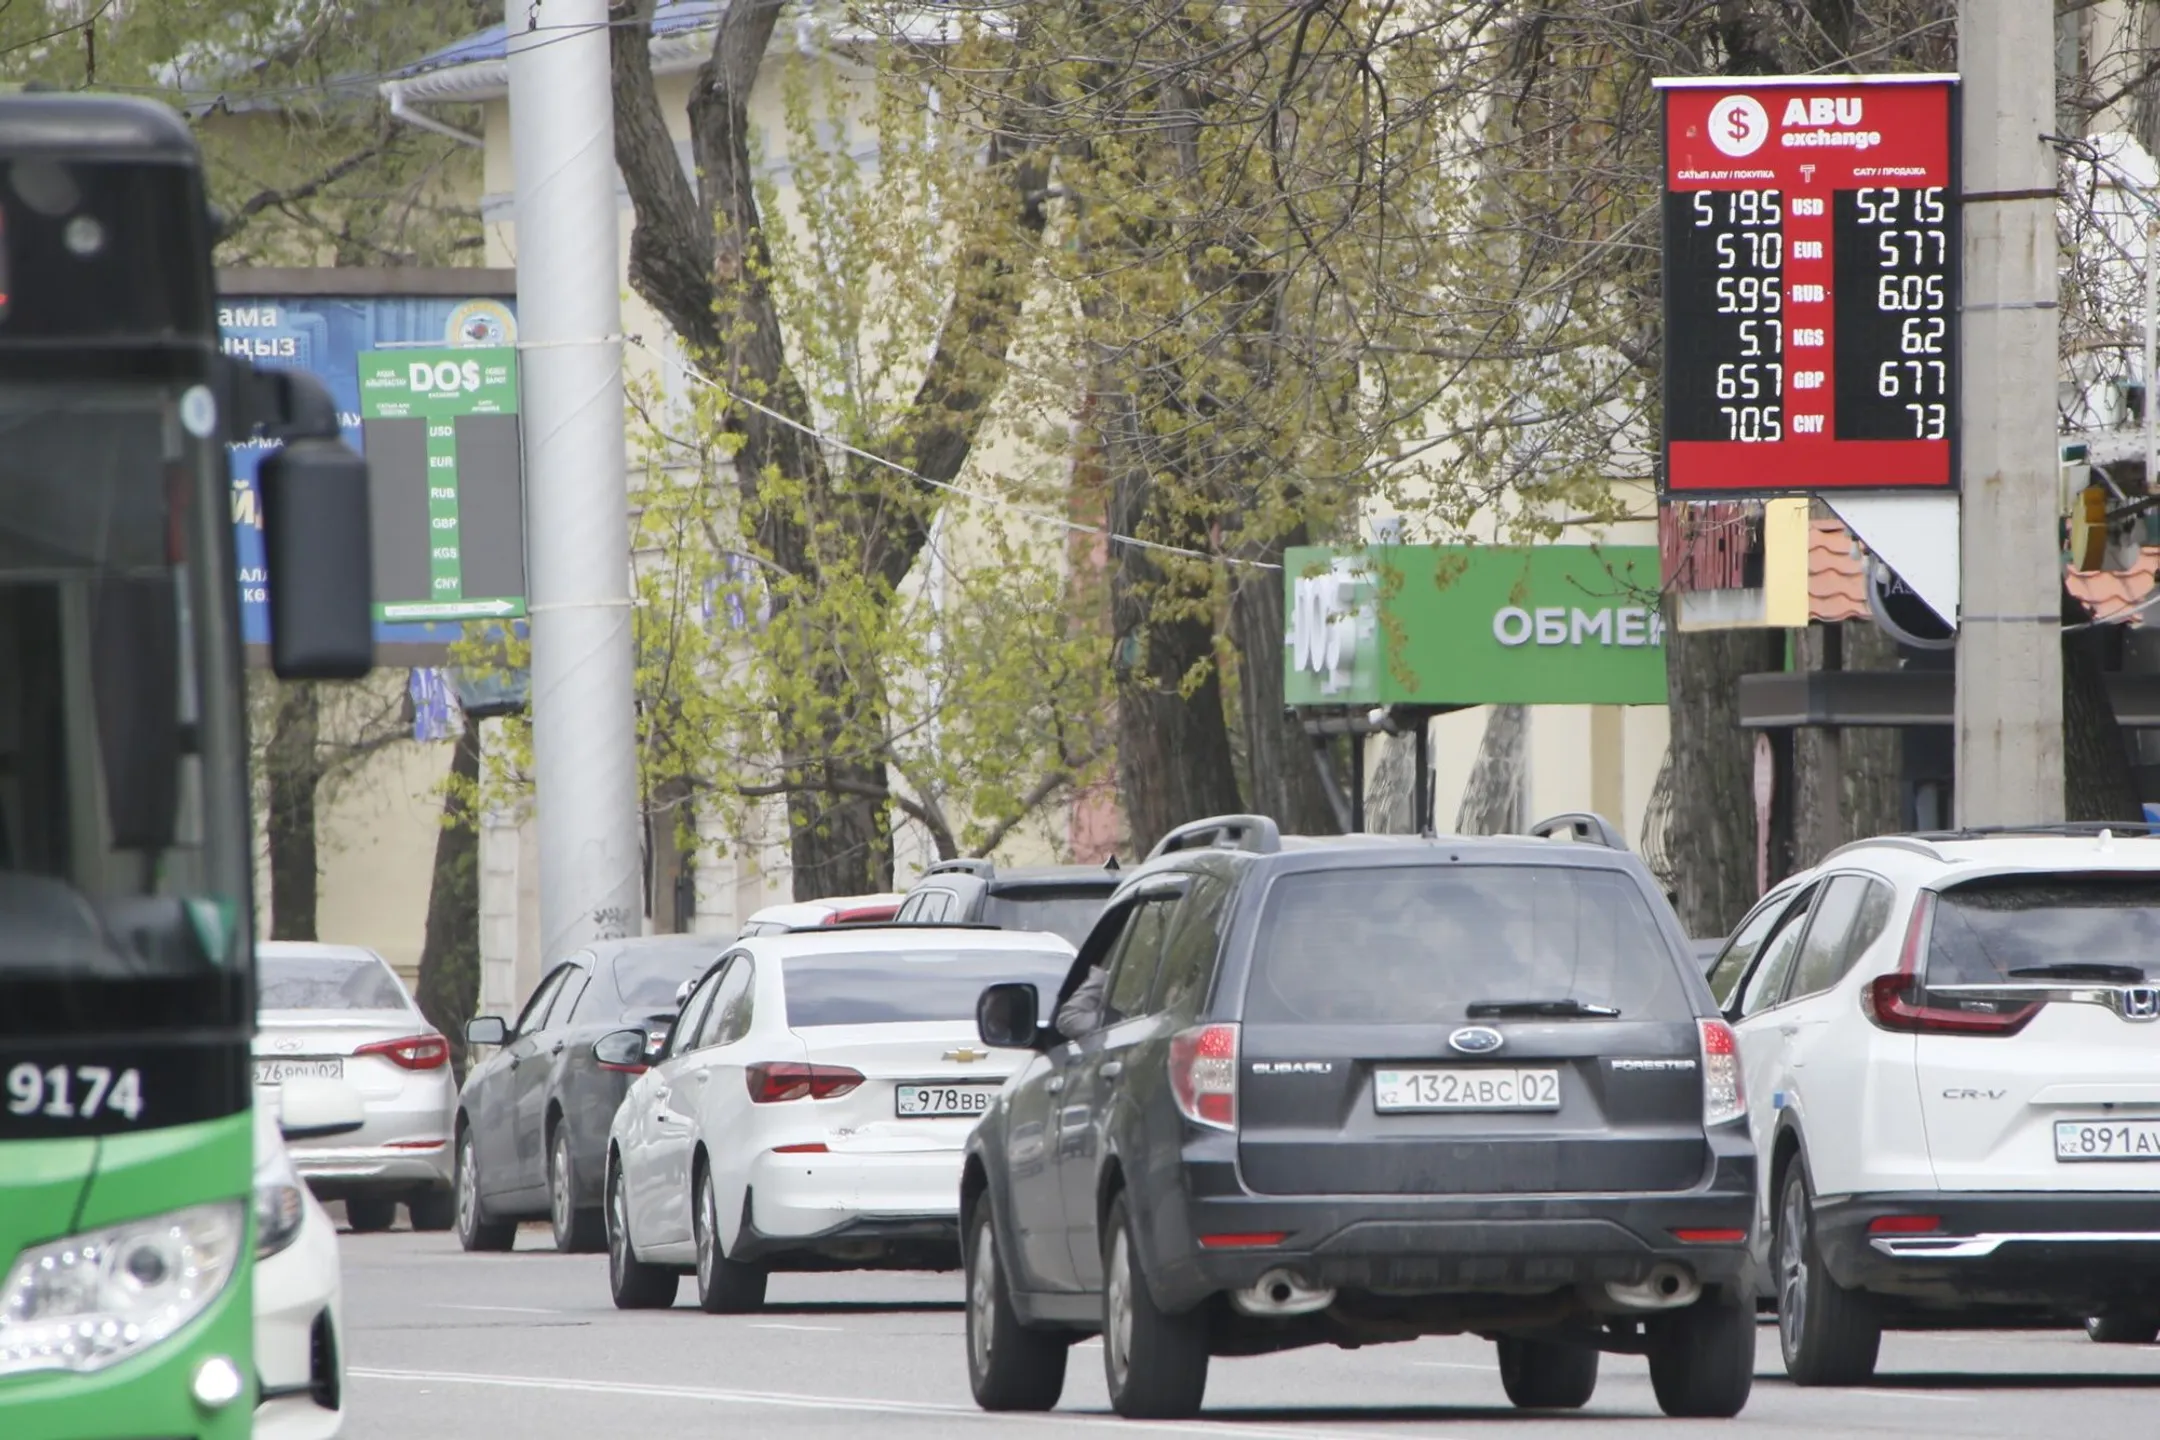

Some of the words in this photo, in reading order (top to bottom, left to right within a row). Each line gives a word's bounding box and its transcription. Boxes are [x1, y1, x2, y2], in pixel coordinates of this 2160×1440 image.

[1781, 98, 1863, 126] ABU
[1781, 129, 1881, 149] exchange
[1677, 169, 1709, 180] САТЫП
[1710, 169, 1728, 180] АЛУ
[1734, 168, 1775, 179] ПОКУПКА
[1853, 167, 1876, 177] САТУ
[1882, 167, 1927, 177] ПРОДАЖА
[1792, 198, 1825, 217] USD
[1716, 232, 1783, 270] 570
[1793, 241, 1824, 260] EUR
[1879, 230, 1945, 267] 577
[1716, 276, 1782, 314] 5.95
[1792, 284, 1825, 303] RUB
[1878, 274, 1945, 311] 6.05
[1739, 319, 1783, 357] 5.7
[1793, 328, 1825, 347] KGS
[1901, 317, 1946, 354] 6.2
[1716, 363, 1783, 400] 657
[1793, 371, 1825, 390] GBP
[1878, 360, 1946, 398] 677
[1720, 406, 1782, 443] 70.5
[1793, 414, 1825, 433] CNY
[1905, 403, 1946, 440] 73
[429, 425, 453, 437] USD
[429, 456, 453, 468] EUR
[431, 487, 456, 499] RUB
[432, 518, 457, 529] GBP
[433, 548, 458, 559] KGS
[434, 577, 459, 589] CNY
[1252, 1062, 1332, 1075] SUBARU
[1611, 1059, 1696, 1071] FORESTER
[6, 1062, 144, 1121] 9174
[1942, 1088, 2007, 1100] CR-V
[917, 1089, 992, 1112] 978BB
